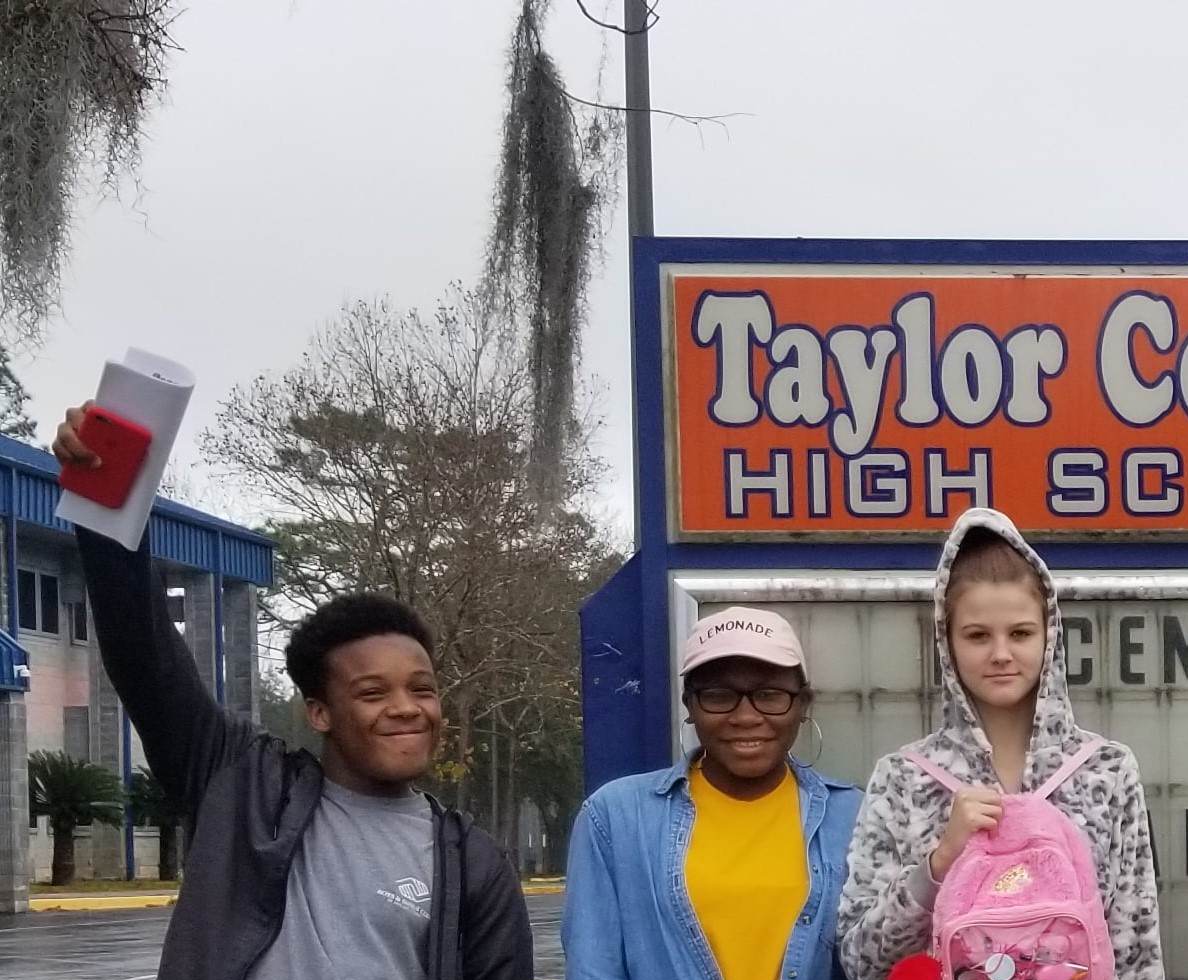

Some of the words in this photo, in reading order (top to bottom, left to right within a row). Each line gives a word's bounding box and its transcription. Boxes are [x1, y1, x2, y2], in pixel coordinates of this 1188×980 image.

[693, 291, 1066, 457] Taylor
[724, 447, 992, 517] HIGH
[699, 620, 773, 644] LEMONADE
